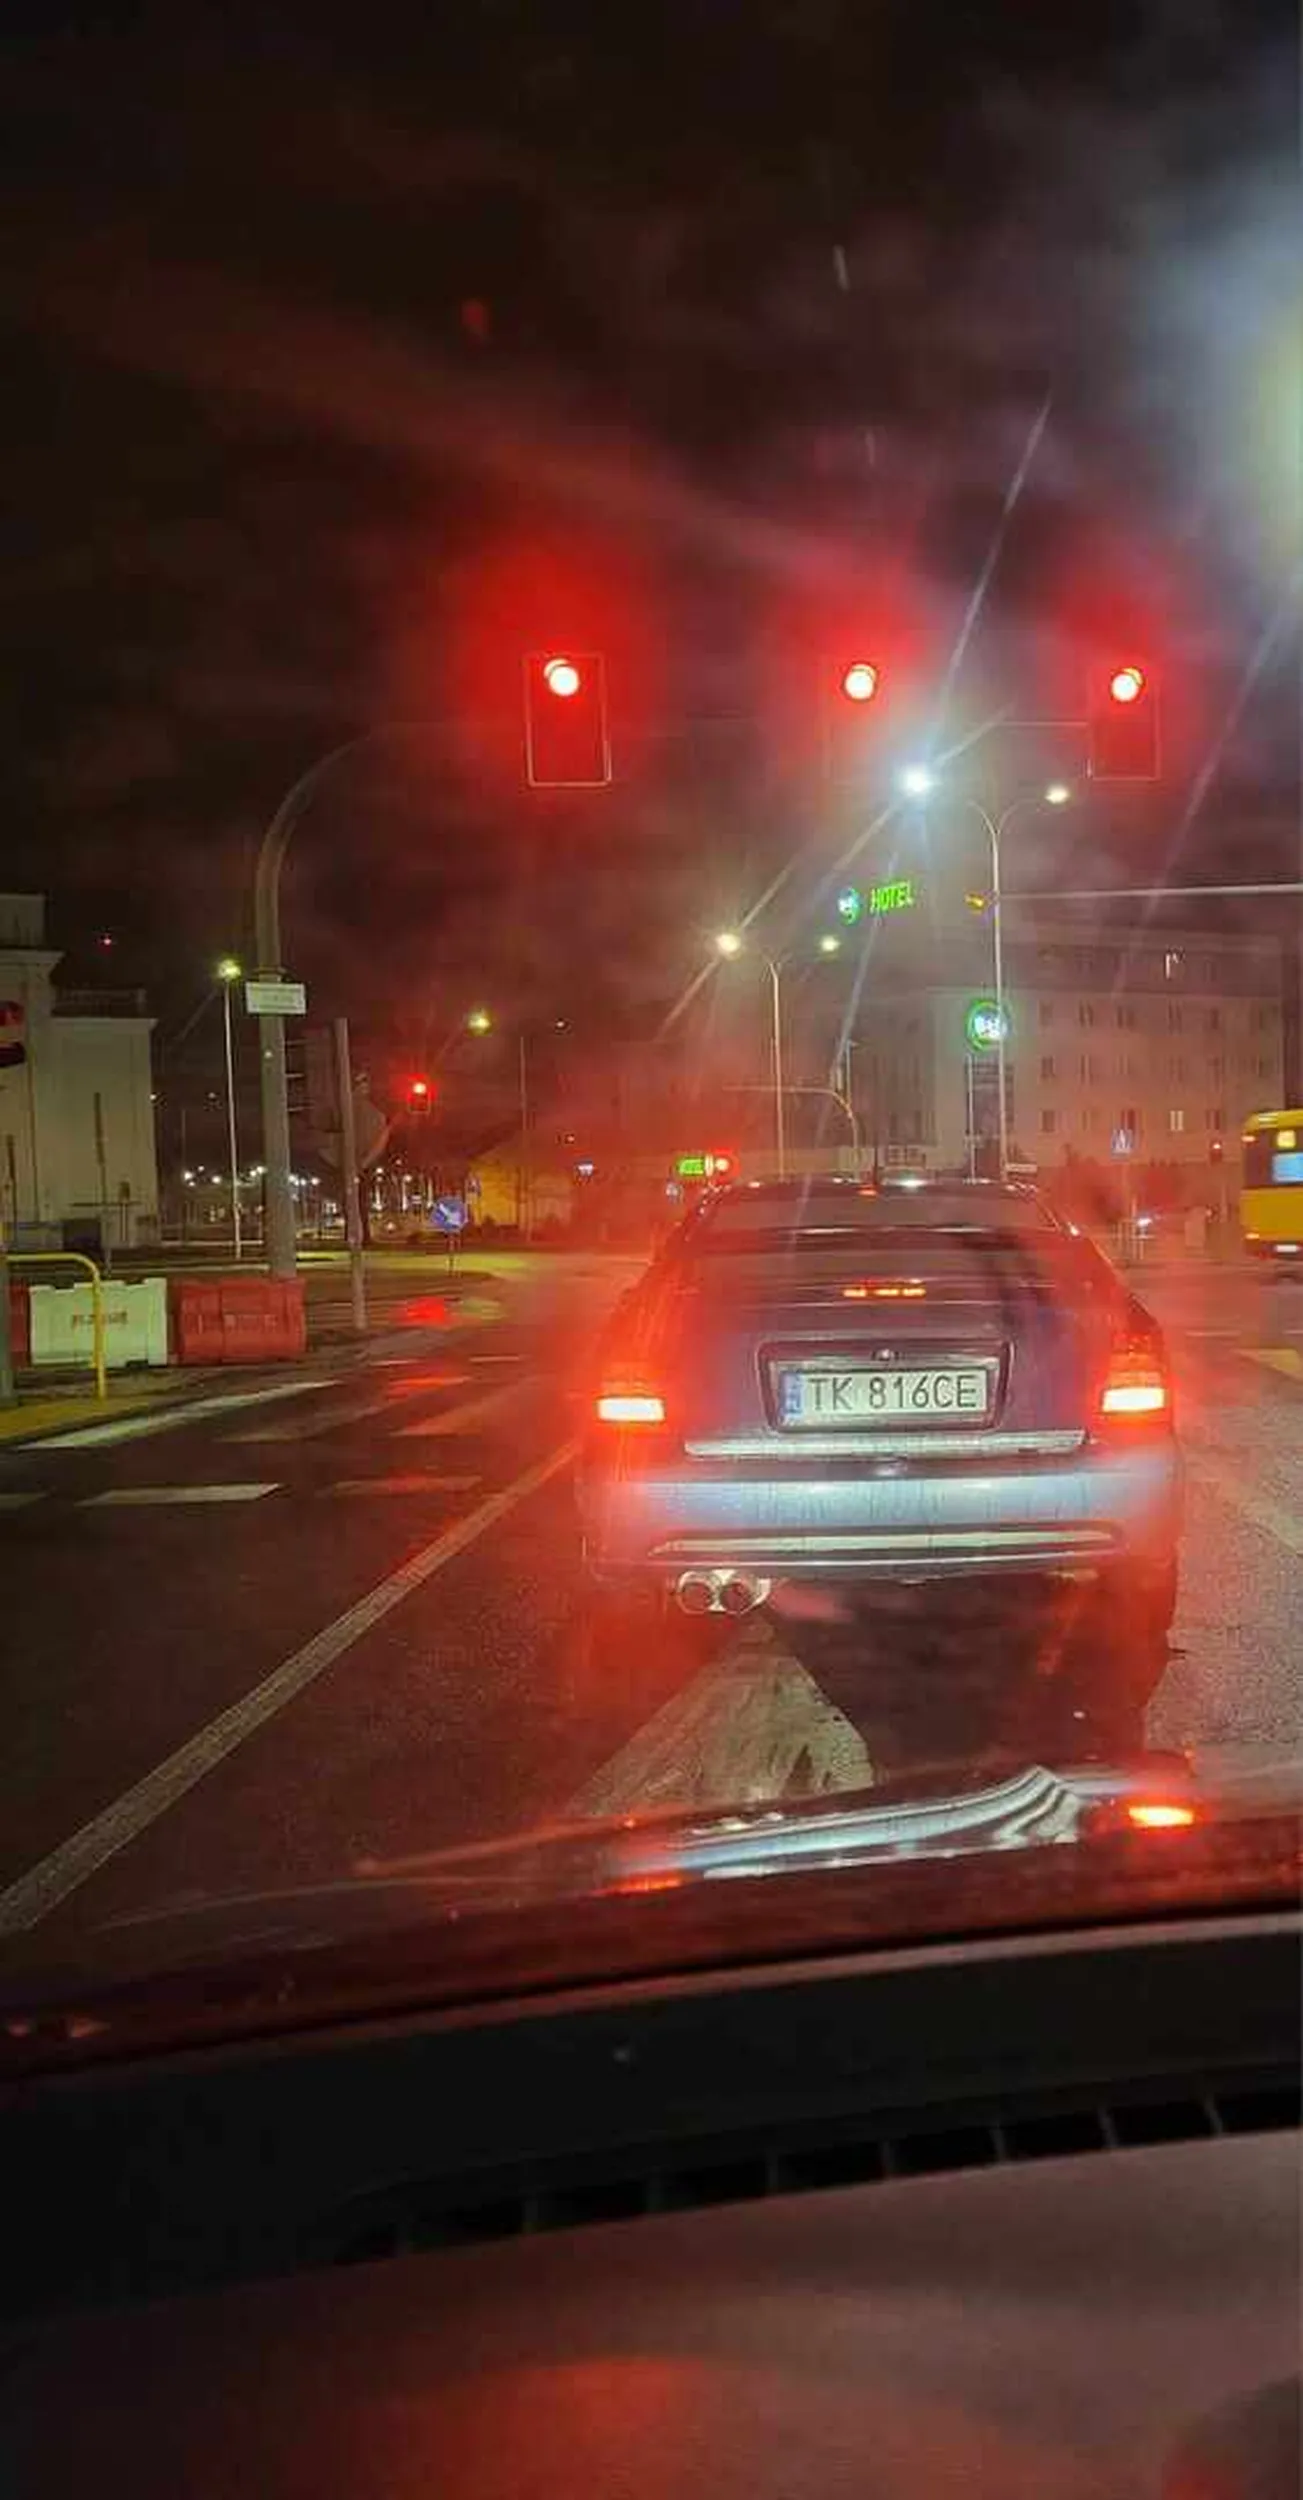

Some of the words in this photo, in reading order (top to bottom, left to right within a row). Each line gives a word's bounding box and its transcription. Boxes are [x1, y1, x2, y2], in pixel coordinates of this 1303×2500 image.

[871, 881, 914, 913] HOTEL
[808, 1377, 854, 1411] TK
[869, 1375, 977, 1409] 816CE
